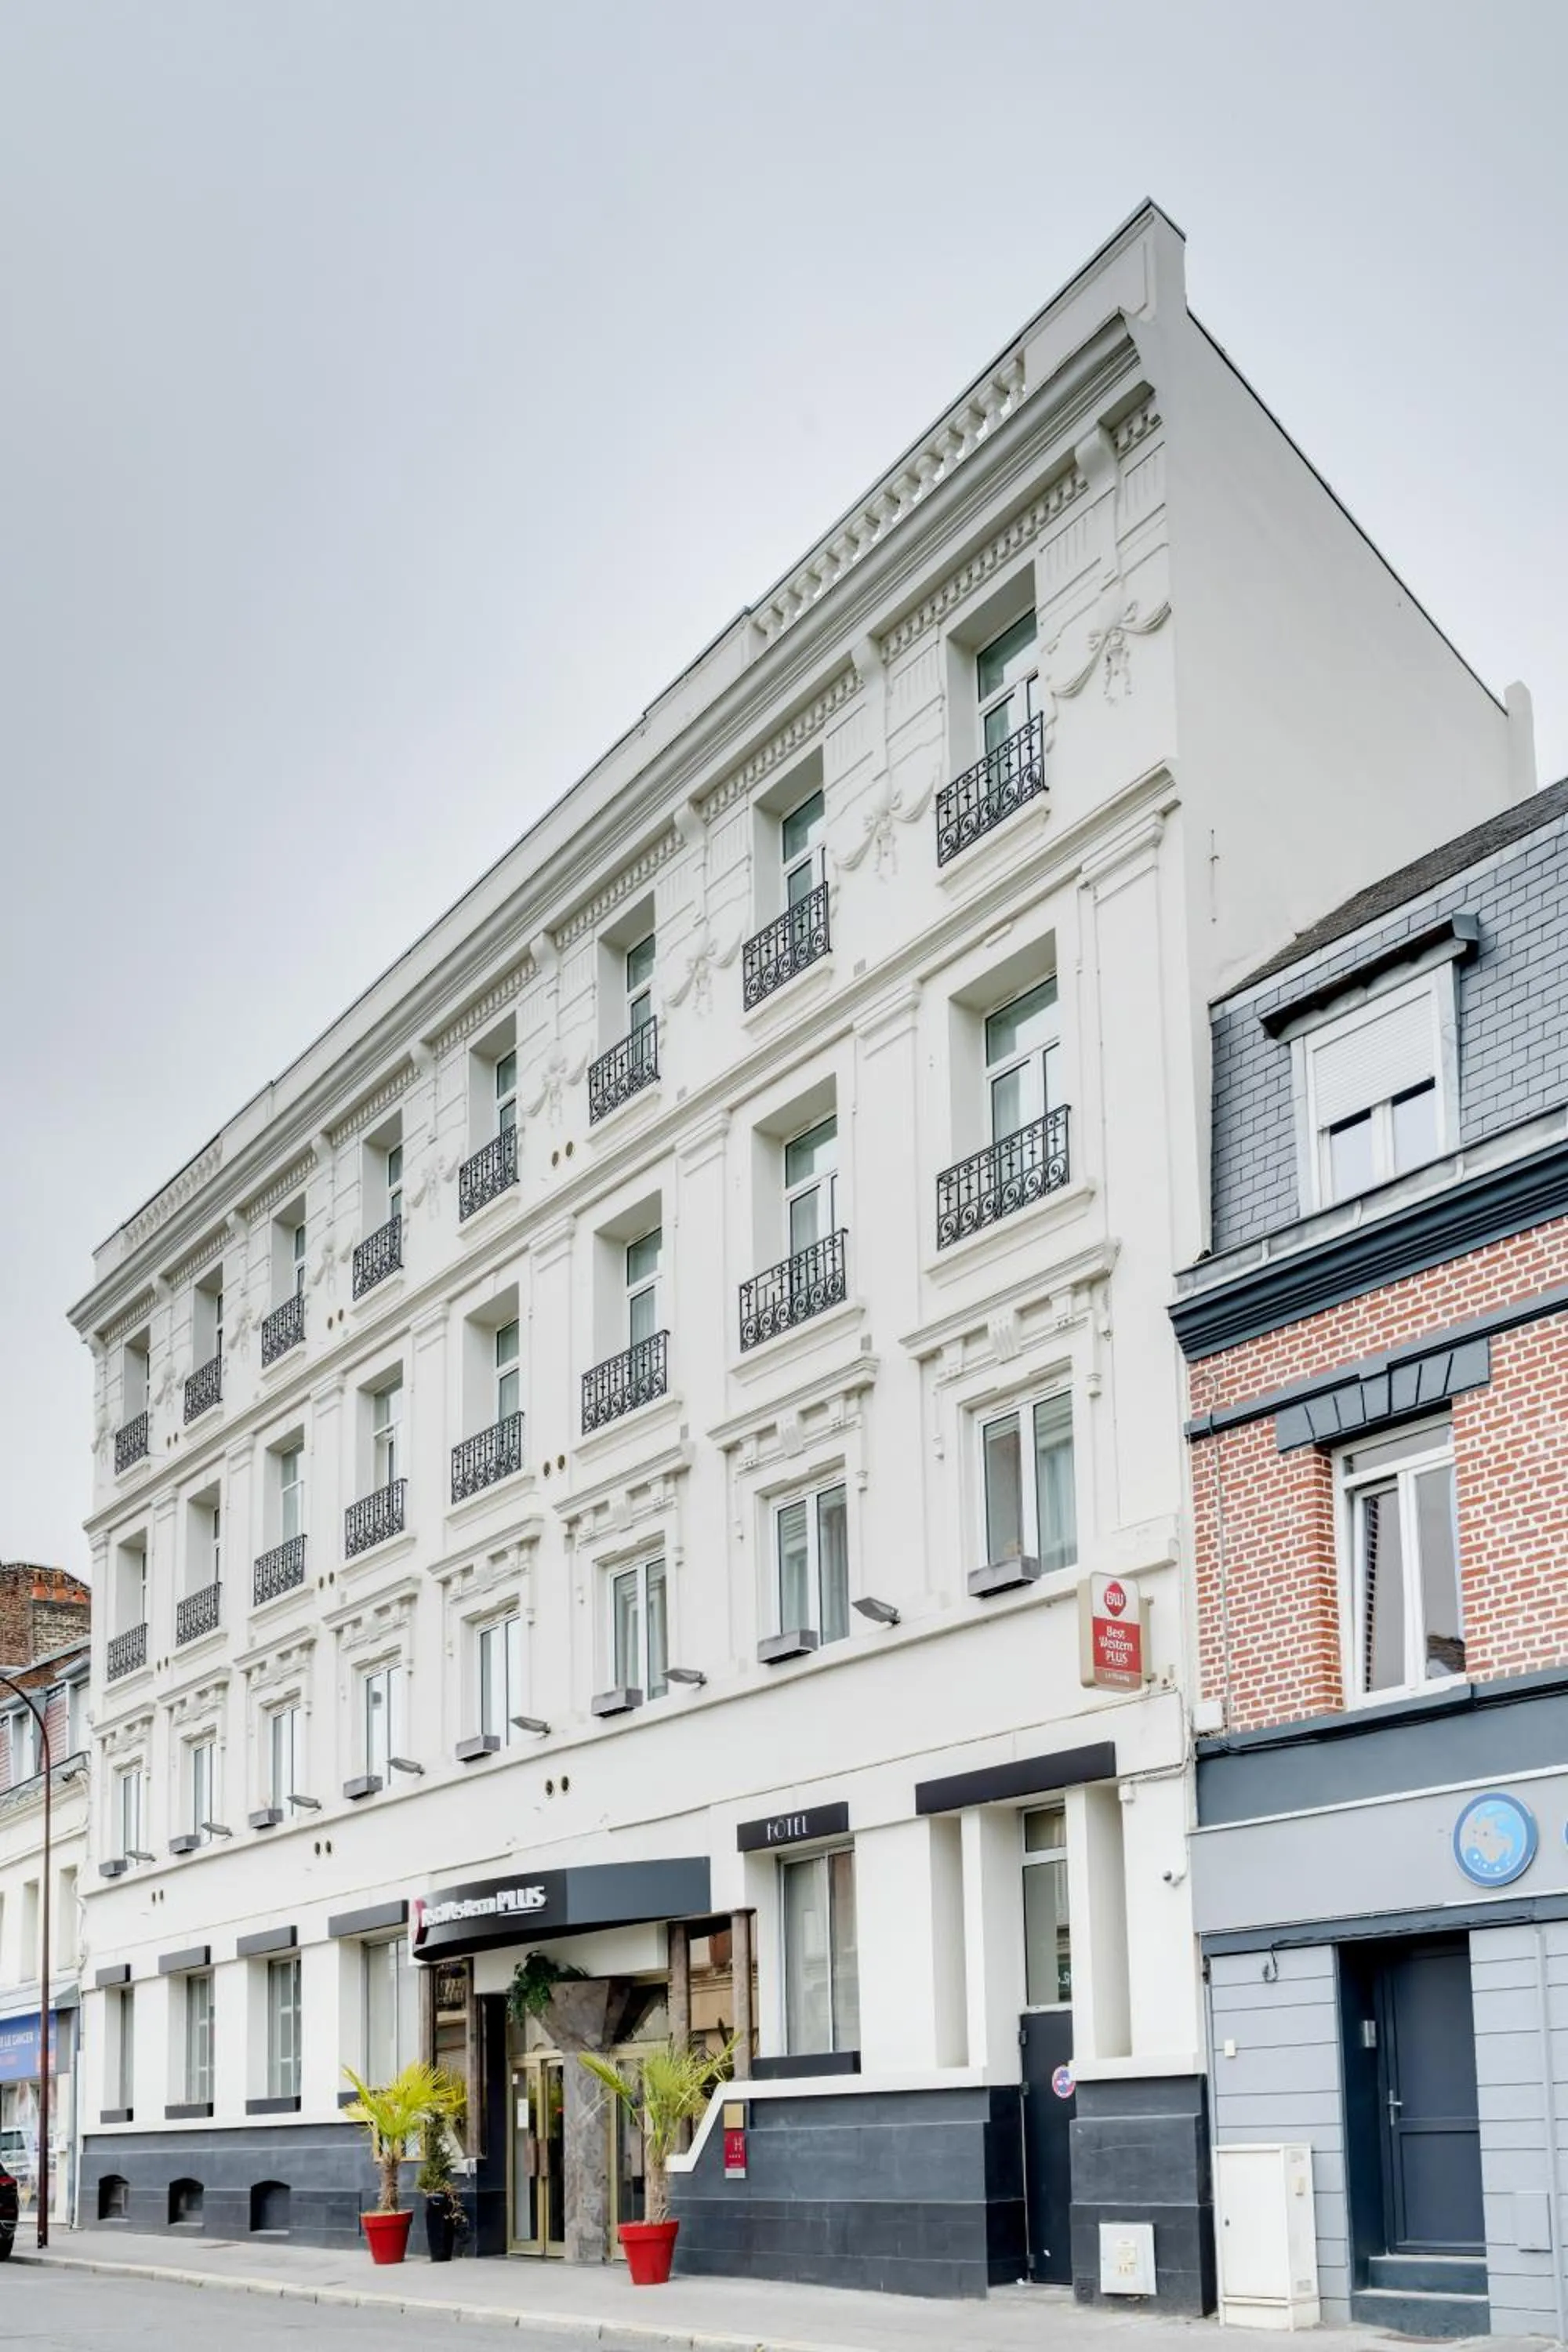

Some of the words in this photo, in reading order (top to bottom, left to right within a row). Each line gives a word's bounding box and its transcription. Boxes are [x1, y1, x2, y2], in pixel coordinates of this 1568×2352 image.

[1106, 1626, 1126, 1639] Best
[1099, 1636, 1133, 1652] Western
[1106, 1650, 1127, 1664] PLUS
[496, 1886, 546, 1911] PLUS
